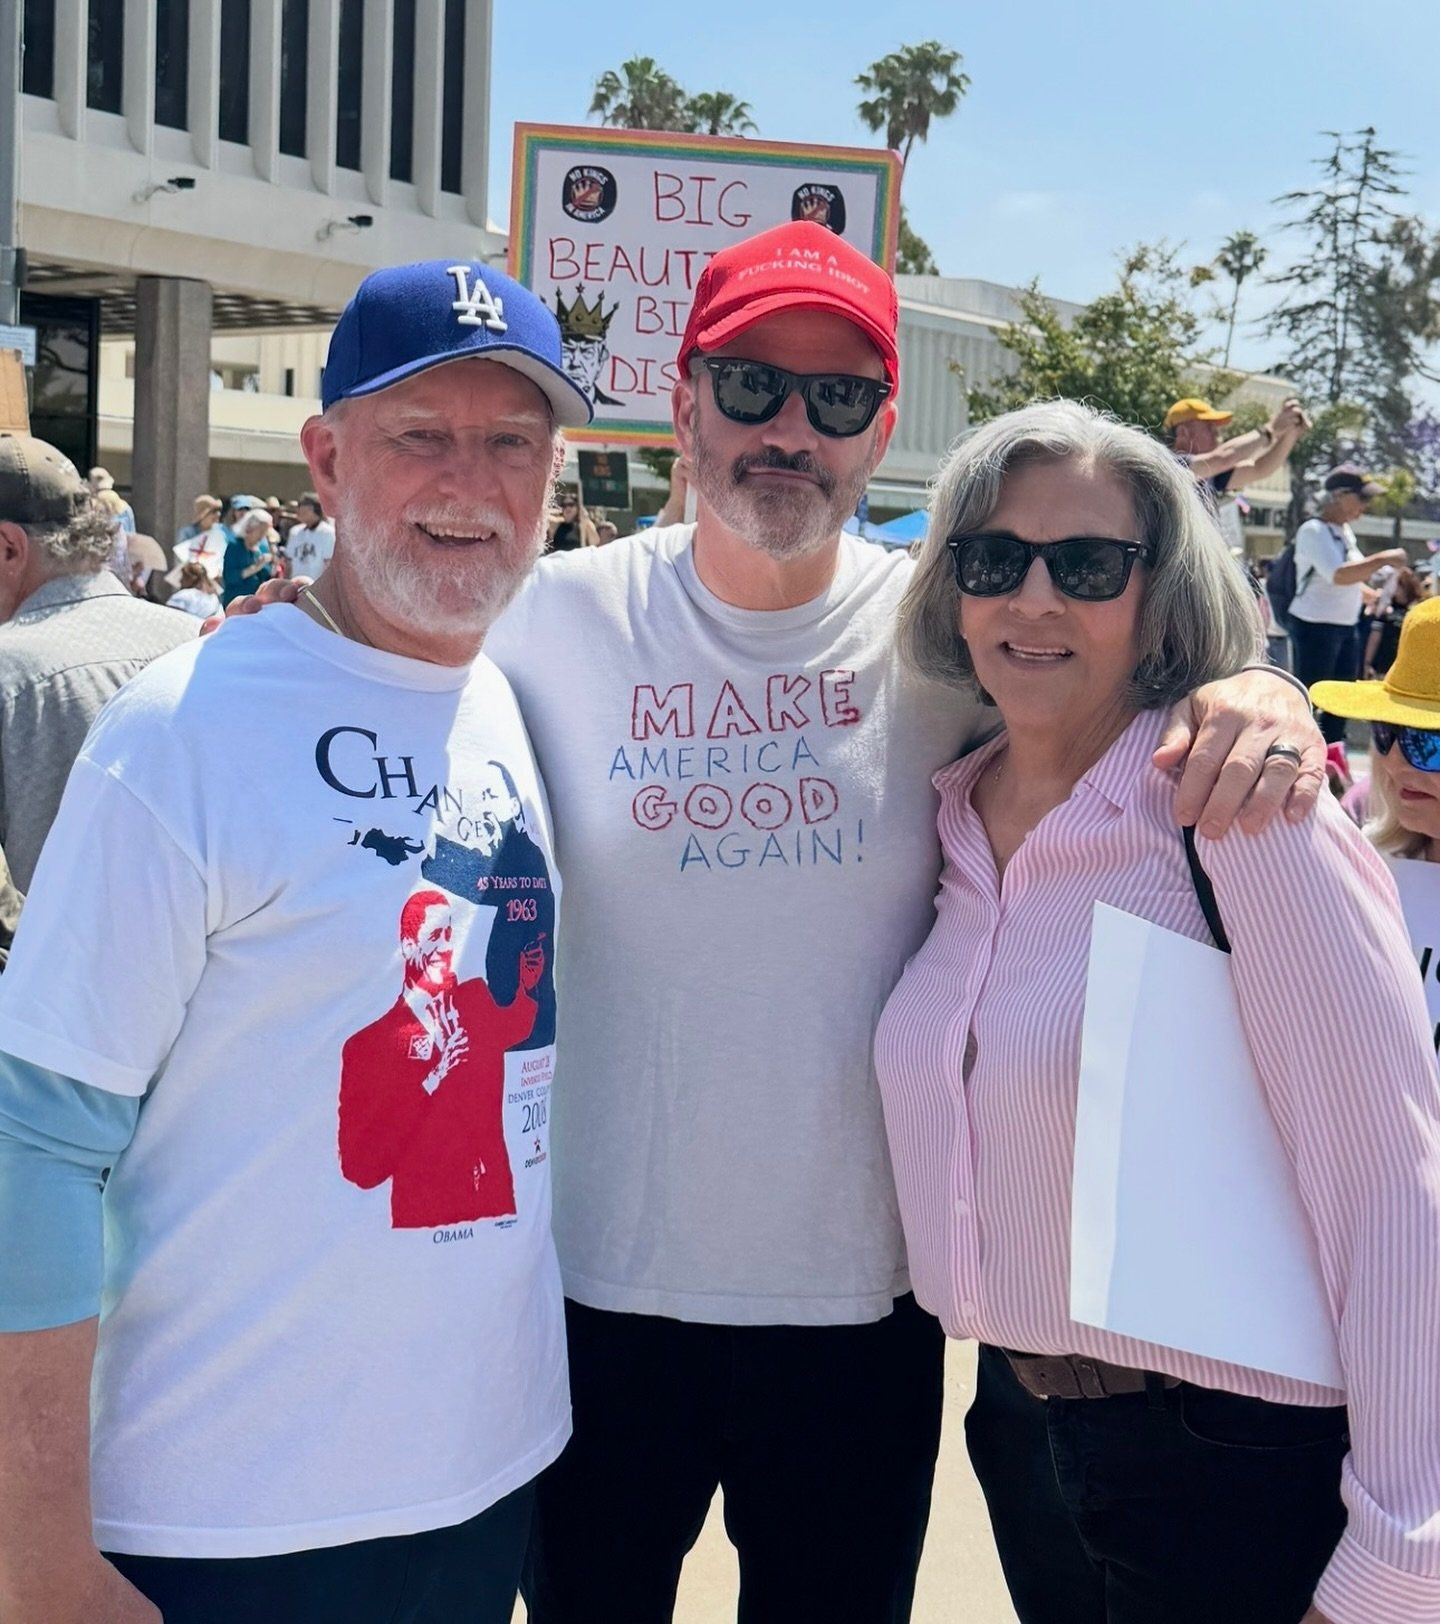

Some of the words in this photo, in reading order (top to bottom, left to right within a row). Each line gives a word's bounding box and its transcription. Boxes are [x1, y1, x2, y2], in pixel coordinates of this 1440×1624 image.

[654, 170, 752, 228] BIG
[776, 247, 783, 257] I
[789, 247, 820, 261] AM
[827, 255, 839, 266] A
[446, 265, 509, 332] LA
[635, 295, 689, 337] BI
[610, 354, 679, 396] DIS
[631, 670, 862, 741] MAKE
[609, 736, 820, 781] AMERICA
[632, 776, 839, 831] GOOD
[680, 818, 863, 872] AGAIN!
[477, 877, 489, 891] 45
[490, 876, 518, 890] YEARS
[519, 877, 531, 889] TO
[506, 898, 538, 923] 1963
[507, 1089, 534, 1105] DENVER
[432, 1226, 475, 1244] OBAMA
